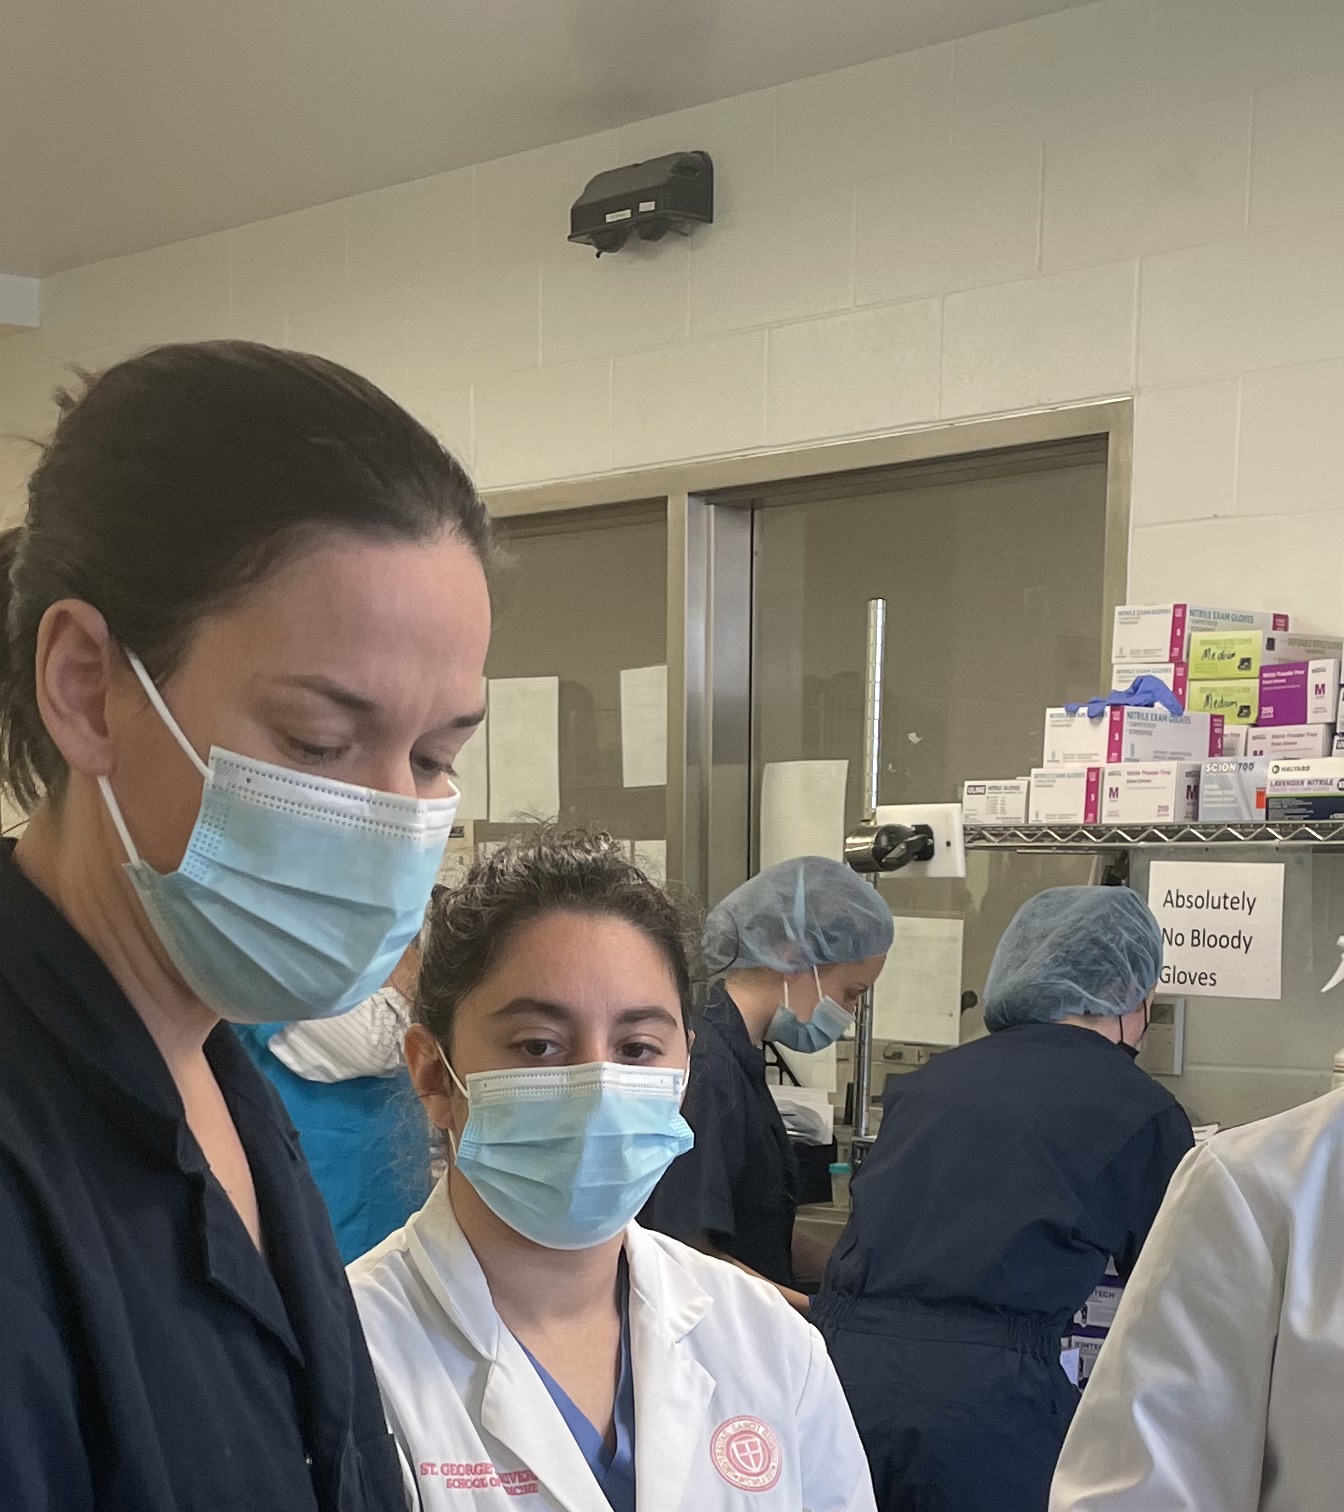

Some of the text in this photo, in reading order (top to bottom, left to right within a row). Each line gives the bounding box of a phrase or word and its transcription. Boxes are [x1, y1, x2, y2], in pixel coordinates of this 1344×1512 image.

[1189, 608, 1254, 624] NITRILE EXAM GLOVES
[1315, 684, 1326, 695] M
[1203, 694, 1238, 709] Medium
[1127, 711, 1149, 721] NITRILE
[1150, 713, 1168, 722] EXAM
[1206, 762, 1255, 773] SCION 700
[1270, 779, 1334, 787] LAVENDER NITRILE
[1109, 787, 1119, 799] M
[1186, 785, 1198, 800] M
[1163, 888, 1257, 916] Absolutely
[1162, 927, 1253, 955] No Bloody
[1159, 965, 1217, 987] Gloves
